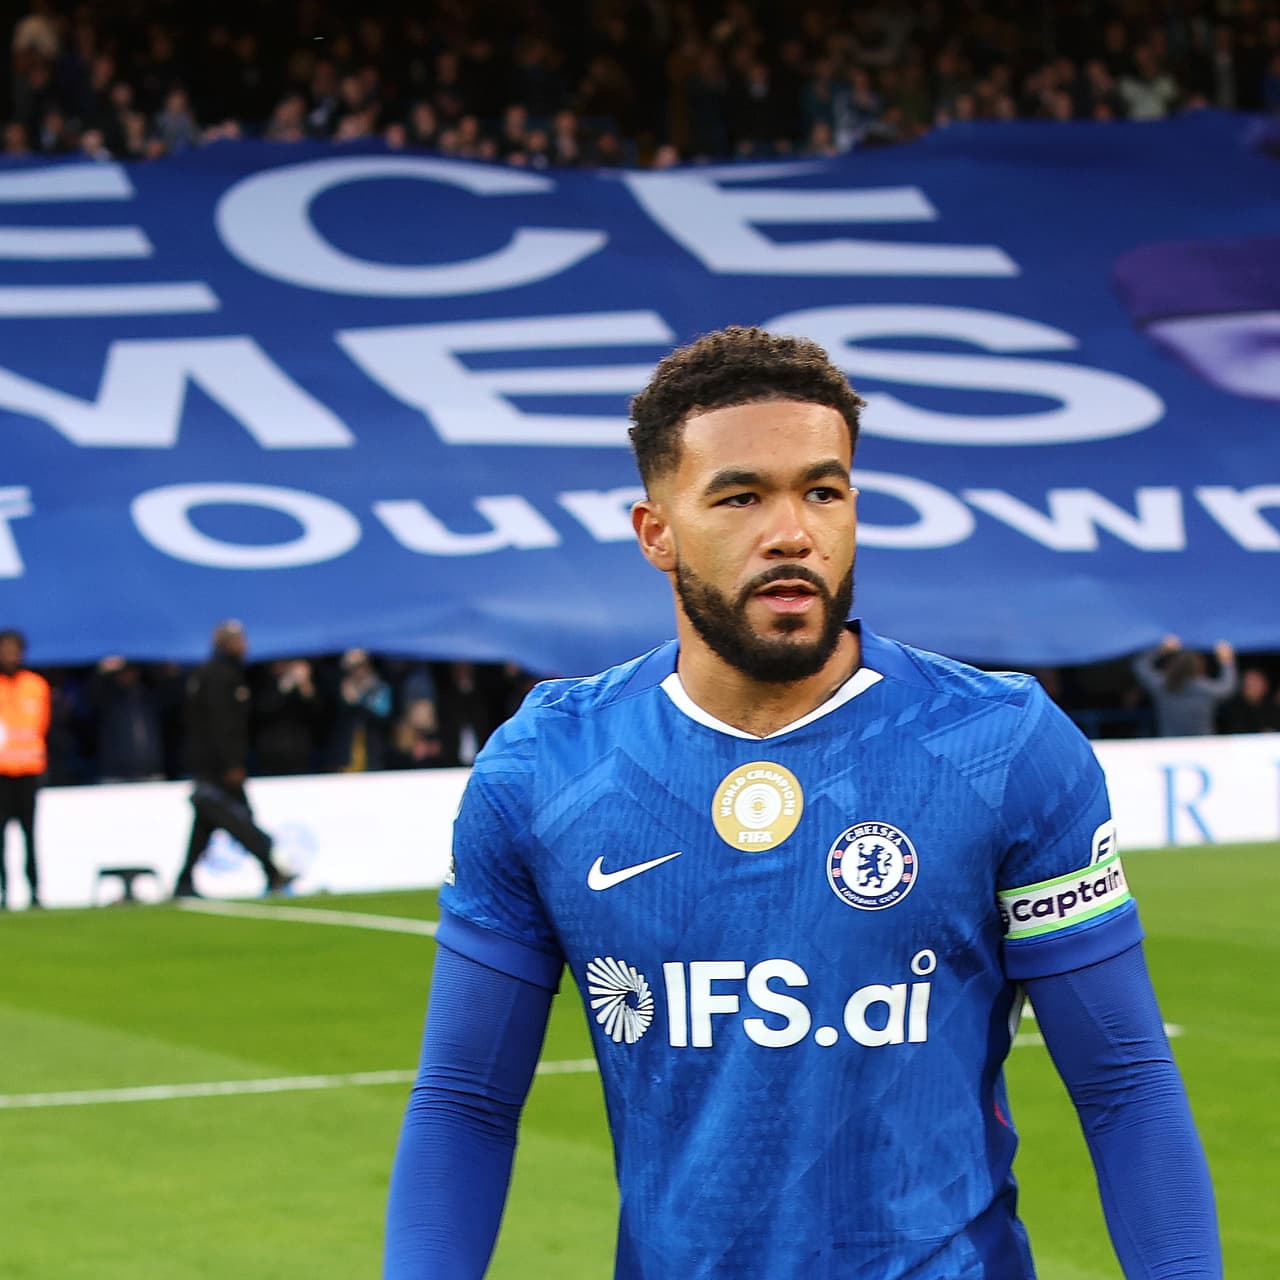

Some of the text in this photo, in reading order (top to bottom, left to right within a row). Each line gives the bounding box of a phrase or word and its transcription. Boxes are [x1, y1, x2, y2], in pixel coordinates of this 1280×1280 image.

[130, 482, 646, 569] Our
[720, 769, 796, 817] WORLD CHAMPIONS
[737, 831, 773, 844] FIFA
[845, 824, 903, 846] CHELSEA
[663, 949, 937, 1048] IFS.ai
